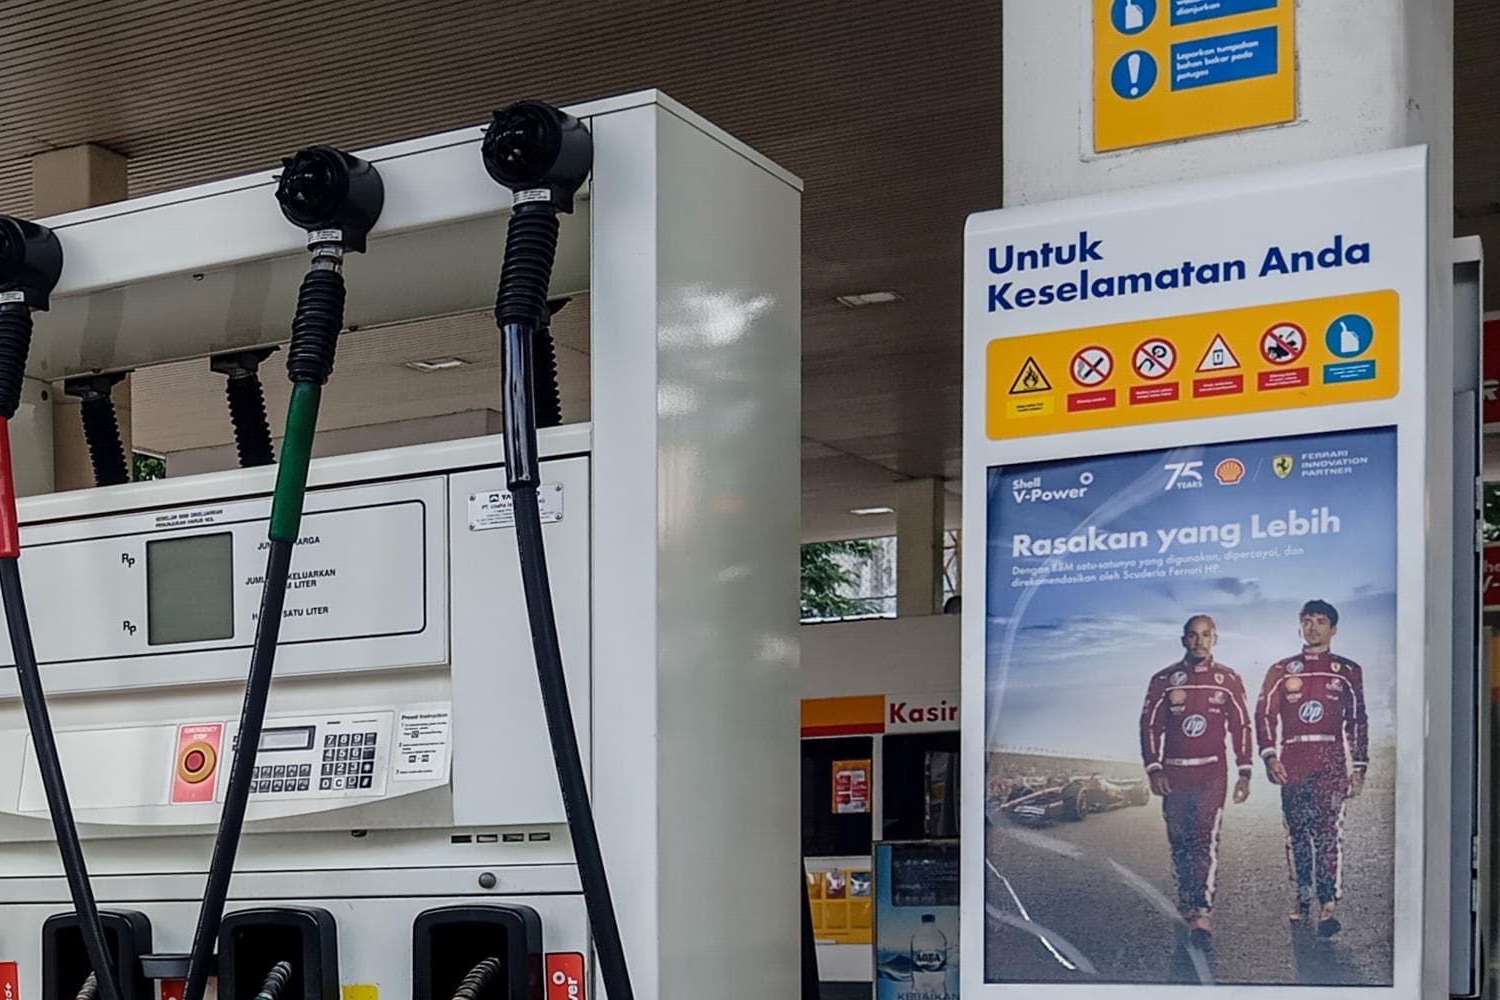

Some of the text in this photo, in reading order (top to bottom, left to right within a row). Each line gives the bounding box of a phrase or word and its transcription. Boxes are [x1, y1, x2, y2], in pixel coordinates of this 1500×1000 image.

[1176, 48, 1215, 60] Laporkan
[988, 231, 1103, 274] Untuk
[987, 235, 1370, 312] Keselamatan Anda
[1301, 450, 1348, 460] FERRARI
[1301, 457, 1368, 469] INNOVATION
[1164, 461, 1204, 491] 75
[1301, 467, 1352, 477] PARTNER
[1012, 477, 1041, 491] Shell
[1176, 480, 1203, 489] YEARS
[1013, 486, 1088, 503] V-Power
[1012, 506, 1340, 558] Rasakan yang Lebih
[296, 536, 320, 545] ARGA
[122, 553, 135, 567] Rp
[1012, 565, 1049, 577] Dengan
[1138, 556, 1163, 569] yang
[1283, 545, 1304, 556] dan
[245, 576, 266, 585] JUML
[1099, 571, 1119, 582] oleh
[1123, 567, 1166, 579] Scuderia
[1169, 565, 1202, 576] Ferrari
[294, 580, 317, 589] LITER
[283, 606, 329, 617] SATU LITER
[123, 621, 136, 635] Rp
[890, 700, 958, 723] Kasir
